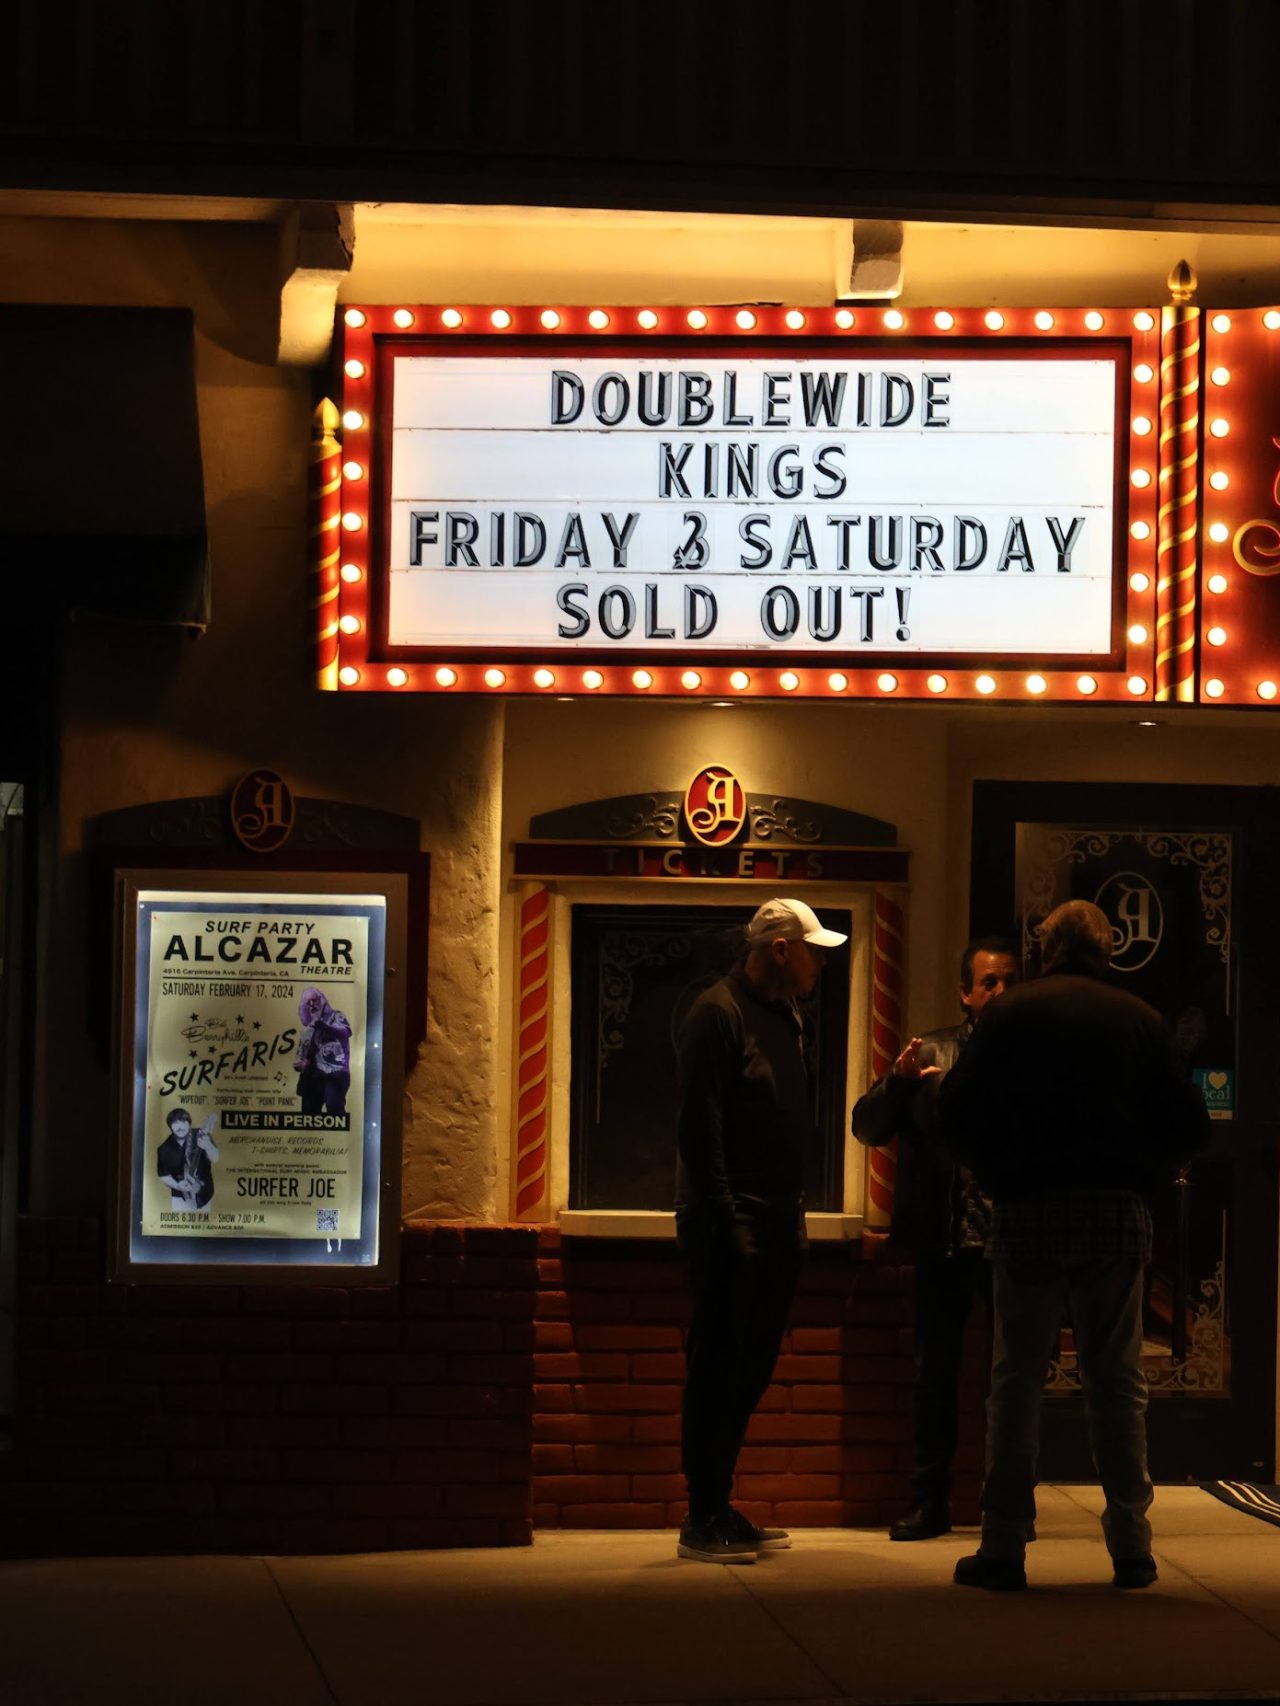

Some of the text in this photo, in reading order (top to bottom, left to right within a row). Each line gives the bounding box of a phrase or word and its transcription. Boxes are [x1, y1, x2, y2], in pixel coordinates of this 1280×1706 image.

[551, 370, 952, 428] DOUBLEWIDE
[658, 442, 847, 500] KINGS
[409, 511, 641, 571] FRIDAY
[739, 514, 1086, 573] SATURDAY
[557, 583, 912, 642] SOLD OUT!
[605, 849, 824, 877] TICKETS
[205, 920, 315, 935] SURF PARTY
[163, 935, 354, 965] ALCAZAR
[300, 964, 352, 976] THEATRE
[162, 983, 206, 996] SATURDAY
[209, 983, 252, 997] FEBRUARY
[271, 984, 294, 998] 2024
[160, 1029, 296, 1096] SURFARIS
[225, 1113, 346, 1128] LIVE IN PERSON
[237, 1177, 336, 1198] SURFER JOE
[160, 1212, 179, 1222] DOORS
